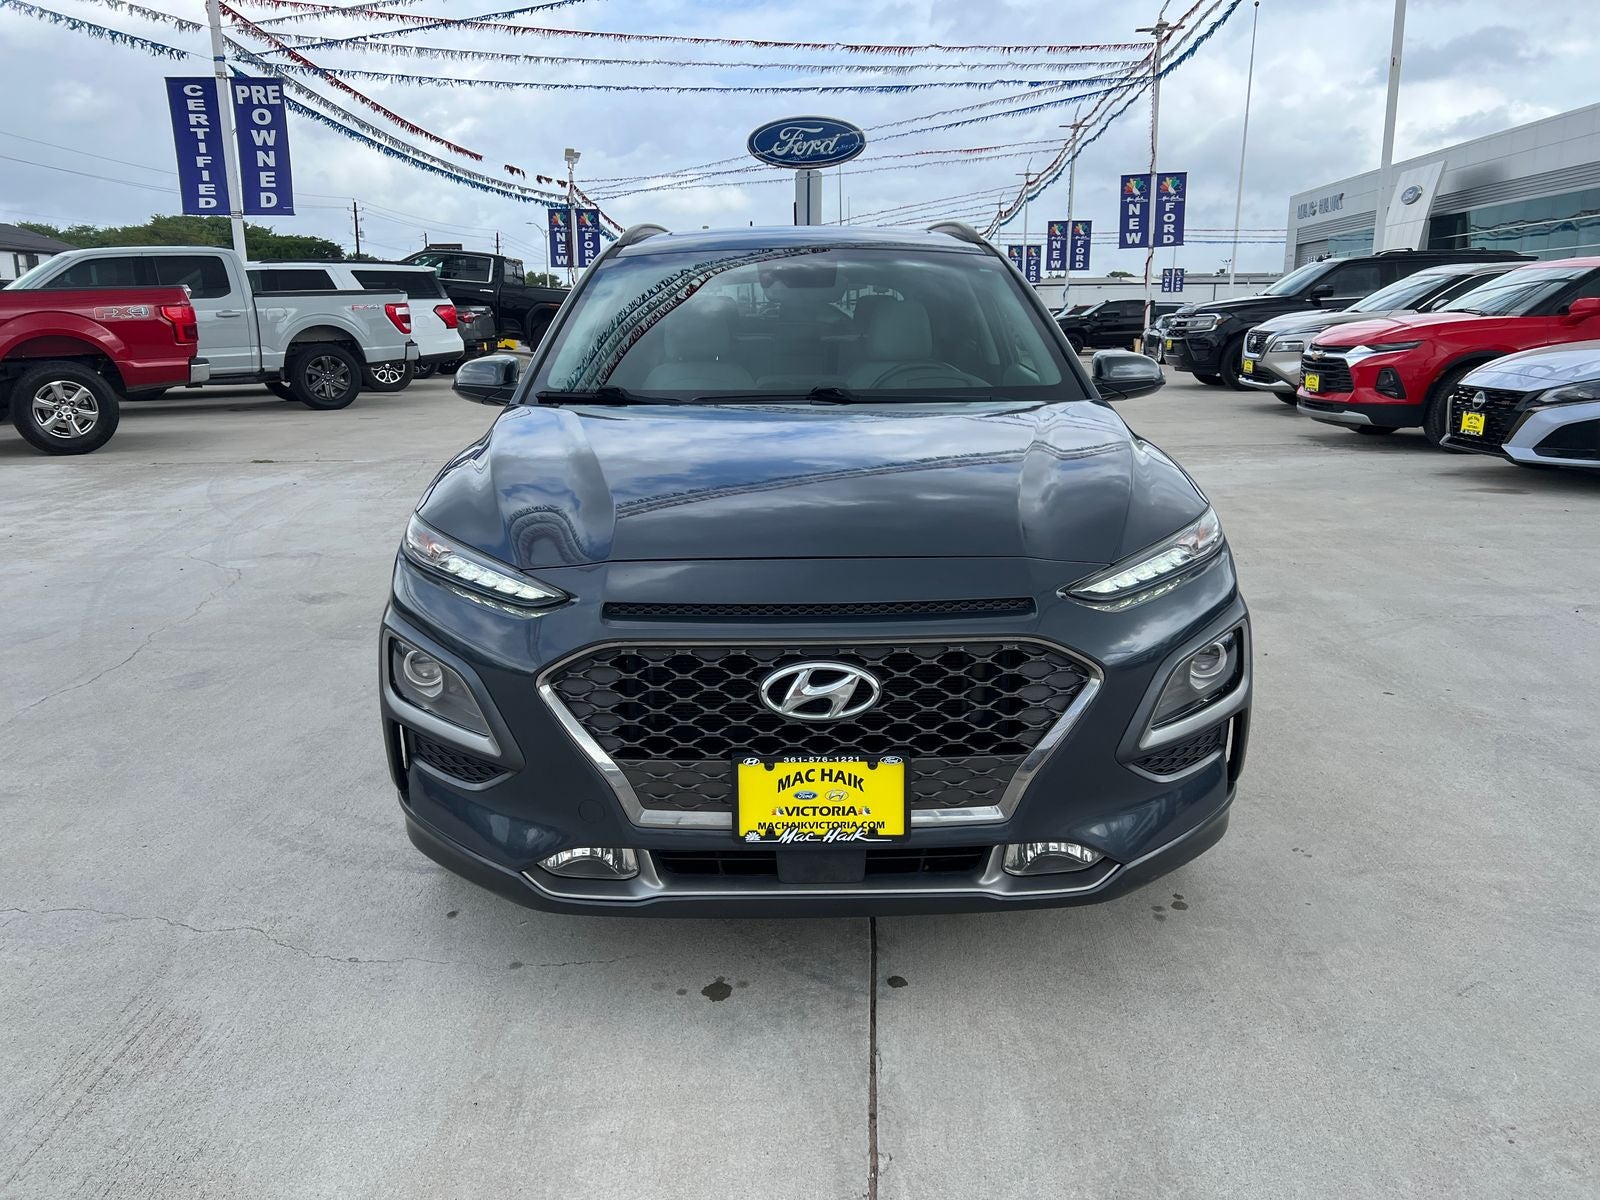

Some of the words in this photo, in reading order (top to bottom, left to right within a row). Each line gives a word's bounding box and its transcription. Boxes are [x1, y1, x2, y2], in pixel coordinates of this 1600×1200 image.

[235, 85, 281, 105] PRE
[183, 84, 217, 209] CERTIFIED
[773, 126, 840, 156] Ford
[250, 108, 278, 208] OWNED
[1126, 203, 1141, 244] NEW
[1163, 202, 1176, 244] FORD
[556, 233, 568, 265] NEW
[1050, 240, 1062, 269] NEW
[1075, 240, 1085, 269] FORD
[1029, 259, 1037, 282] FORD
[93, 305, 150, 320] FX4
[777, 768, 816, 793] MAC
[820, 768, 865, 792] HAIK
[784, 806, 858, 817] VICTORIA
[778, 827, 821, 844] Mac
